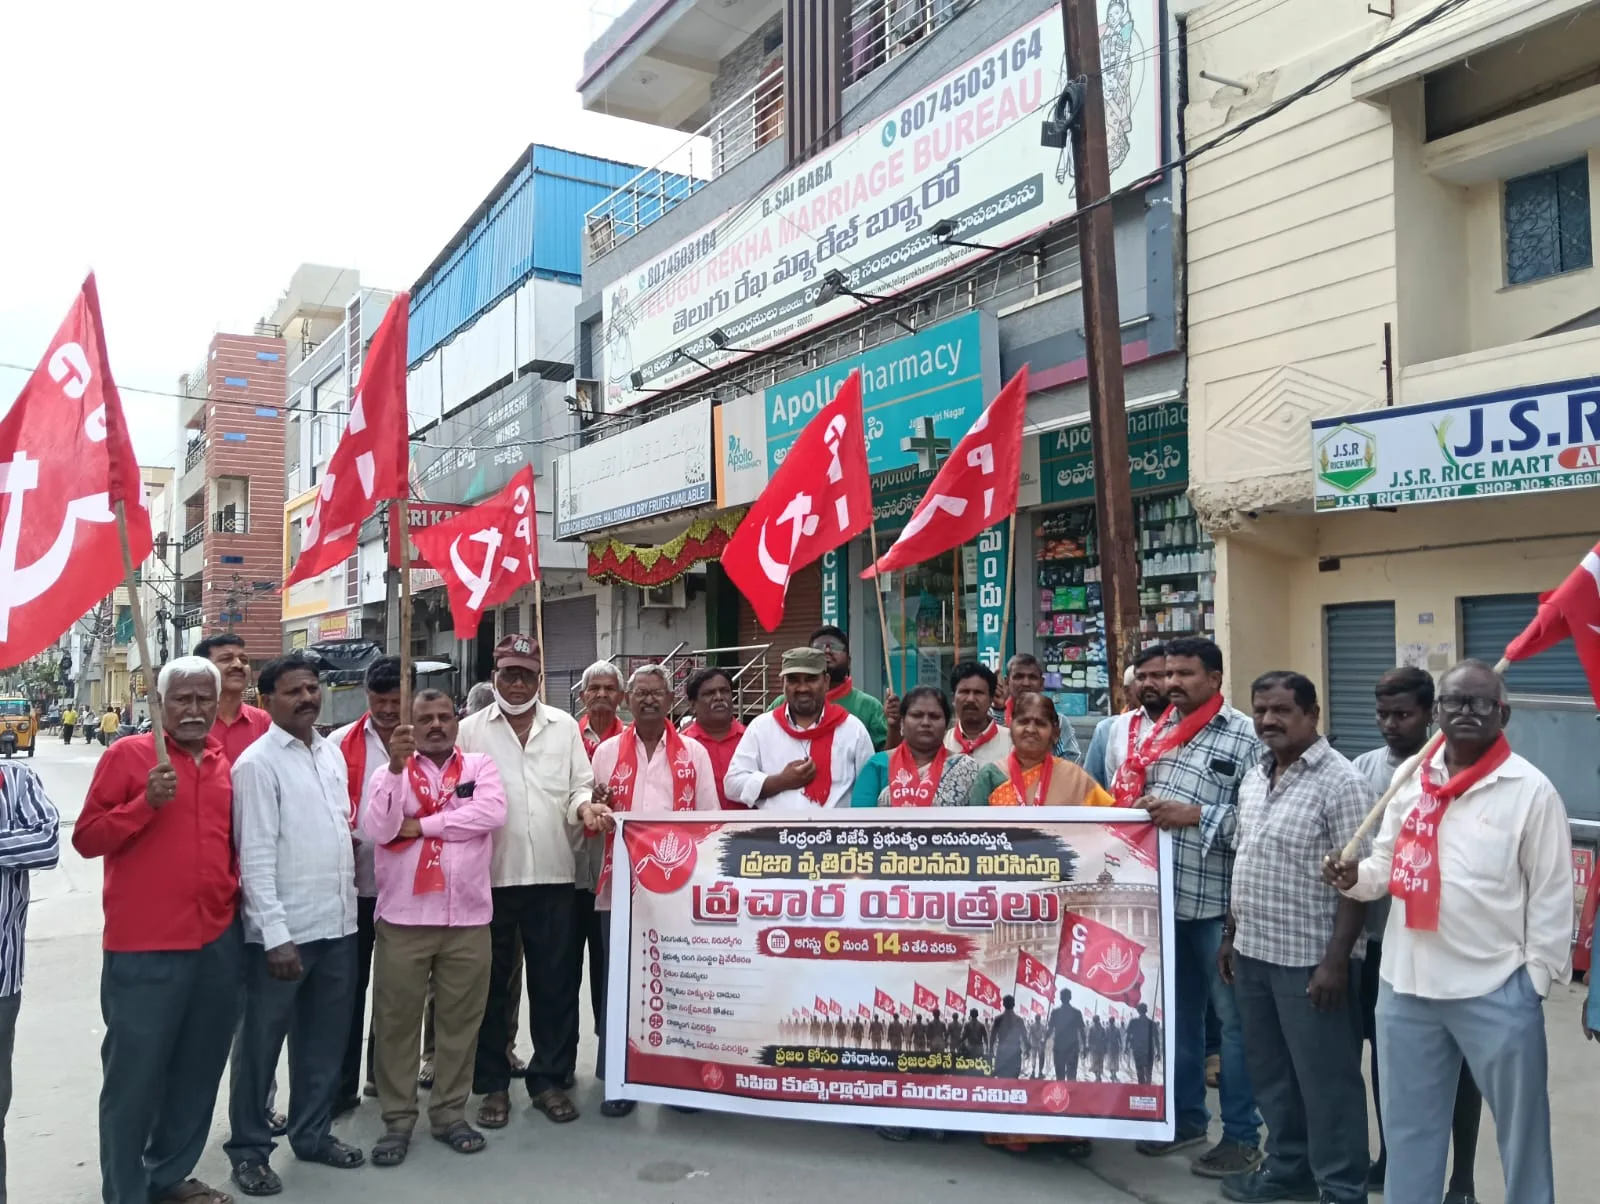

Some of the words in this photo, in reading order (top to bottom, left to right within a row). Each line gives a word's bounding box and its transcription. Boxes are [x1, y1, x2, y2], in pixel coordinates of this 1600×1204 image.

[901, 27, 1042, 138] 8074503164
[706, 226, 773, 287] REKHA
[779, 149, 905, 248] MARRIAGE
[914, 68, 1042, 174] BUREAU
[775, 184, 794, 210] SAI
[797, 160, 833, 197] BABA
[648, 228, 717, 288] 8074503164
[672, 288, 730, 335] తెలుగు
[773, 213, 860, 282] మ్యారేజ్
[866, 157, 962, 233] బ్యూరో
[848, 338, 963, 396] harmacy
[943, 406, 966, 420] Nagar
[1056, 425, 1092, 452] Apo
[1127, 405, 1188, 435] harmac
[728, 448, 753, 473] Apollo
[1330, 461, 1344, 470] RICE
[1345, 458, 1364, 469] MART
[1333, 442, 1359, 458] J.S.R
[1389, 470, 1437, 489] J.S.R.
[1441, 461, 1486, 482] RICE
[1491, 454, 1554, 478] MART
[636, 502, 649, 516] DRY
[649, 495, 670, 512] FRUITS
[670, 486, 706, 508] AVAILABLE
[1376, 488, 1411, 505] RICE
[1414, 484, 1462, 500] MART
[1475, 482, 1517, 496] SHOP:
[1520, 478, 1545, 492] NO:
[677, 768, 694, 779] CPI
[612, 785, 629, 796] CPI
[778, 828, 832, 849] కేంద్రంలో
[872, 831, 928, 851] ప్రభుత్వం
[931, 831, 1013, 851] అనుసరిస్తున్న
[1405, 816, 1434, 837] CPI
[740, 850, 792, 877] ప్రజా
[797, 846, 874, 882] వ్యతిరేక
[880, 850, 970, 876] పాలనను
[976, 853, 1061, 882] నిరసిస్తూ
[1405, 877, 1429, 893] CPI
[691, 881, 847, 925] ప్రచార
[859, 883, 1059, 930] యాత్రలు
[824, 930, 841, 953] 6
[842, 938, 870, 952] నుండి
[873, 931, 901, 955] 14
[1070, 923, 1089, 975] CPI
[902, 1083, 968, 1102] మండల
[972, 1085, 1028, 1104] సమితి
